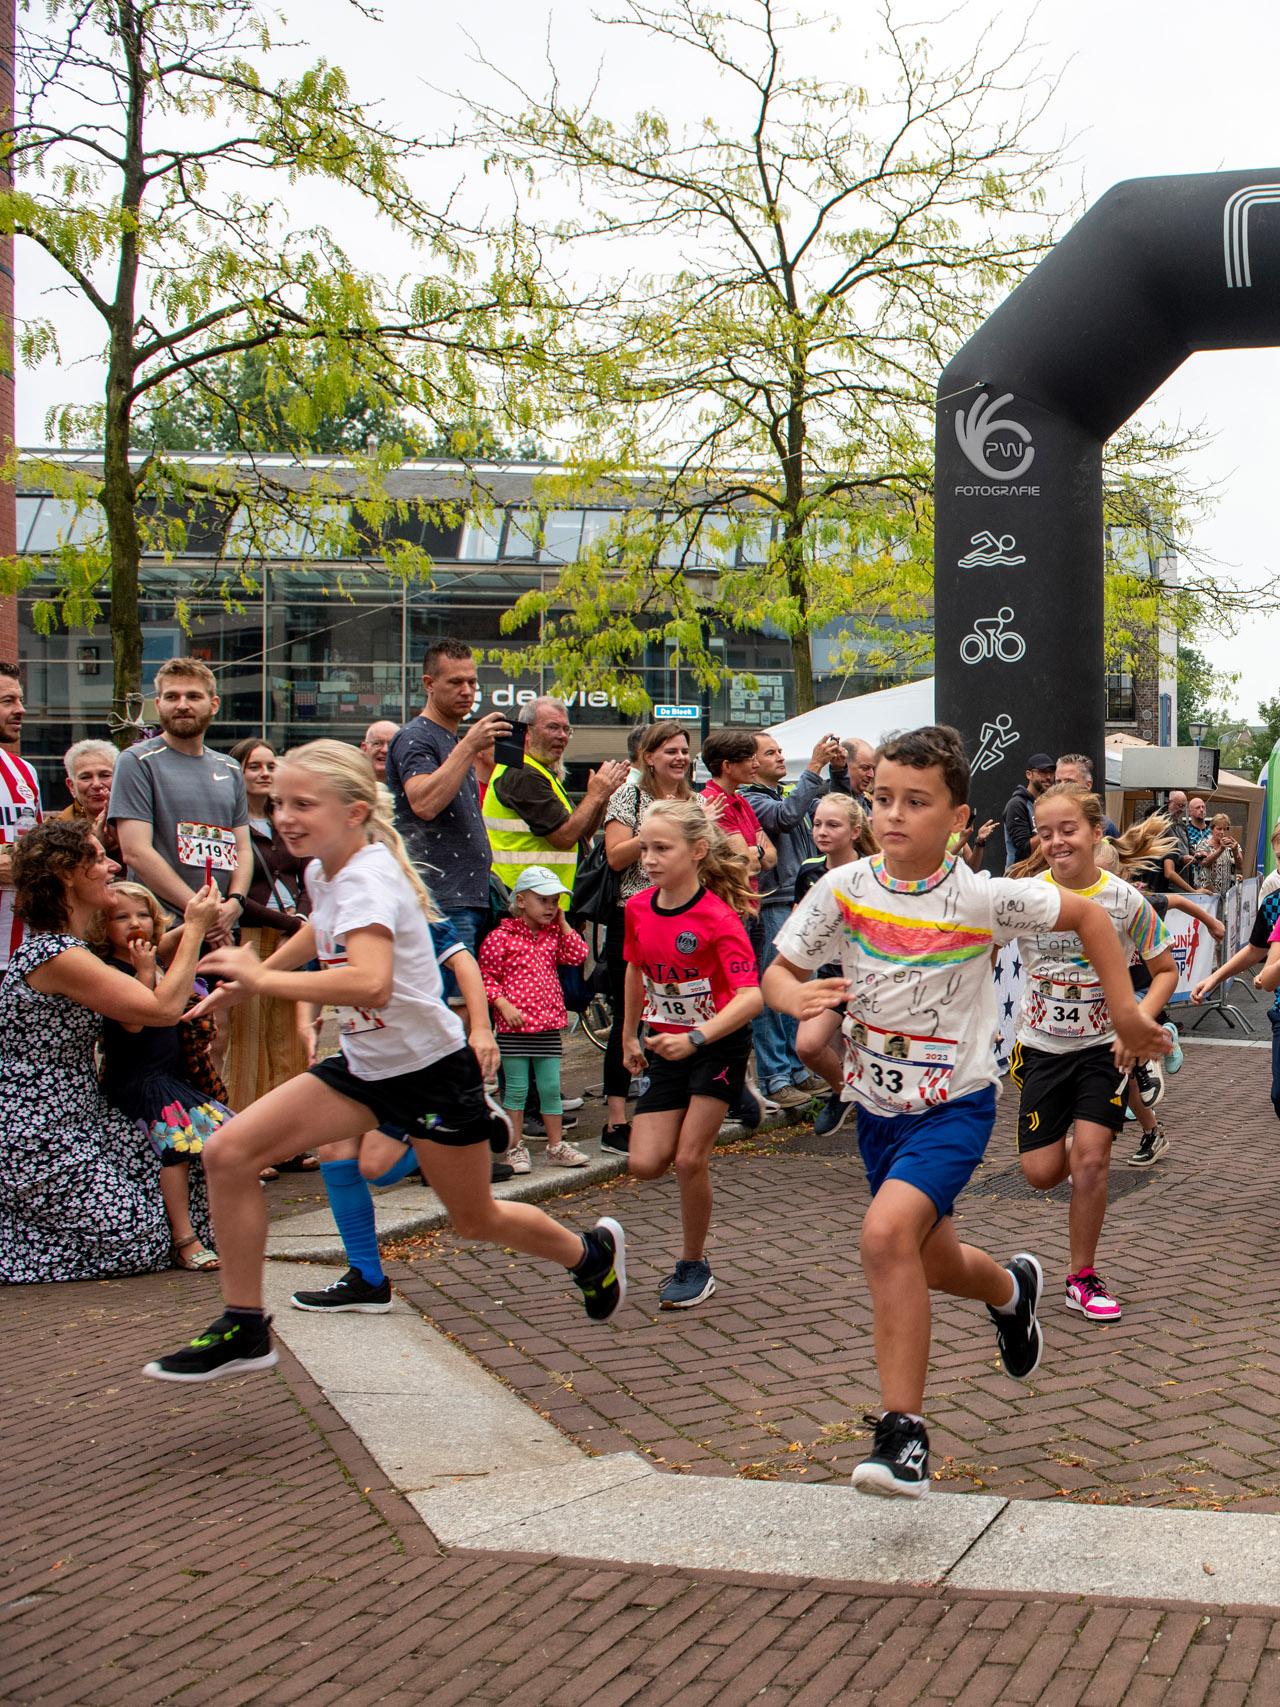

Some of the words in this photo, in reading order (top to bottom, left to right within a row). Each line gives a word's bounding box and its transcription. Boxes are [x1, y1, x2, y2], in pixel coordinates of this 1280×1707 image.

[985, 442, 1023, 458] PW
[954, 485, 1041, 497] FOTOGRAFIE
[196, 842, 222, 858] 119
[1036, 934, 1081, 954] Lope
[662, 1001, 687, 1016] 18
[1053, 1006, 1080, 1023] 34
[925, 1053, 948, 1061] 2023
[870, 1063, 904, 1094] 33
